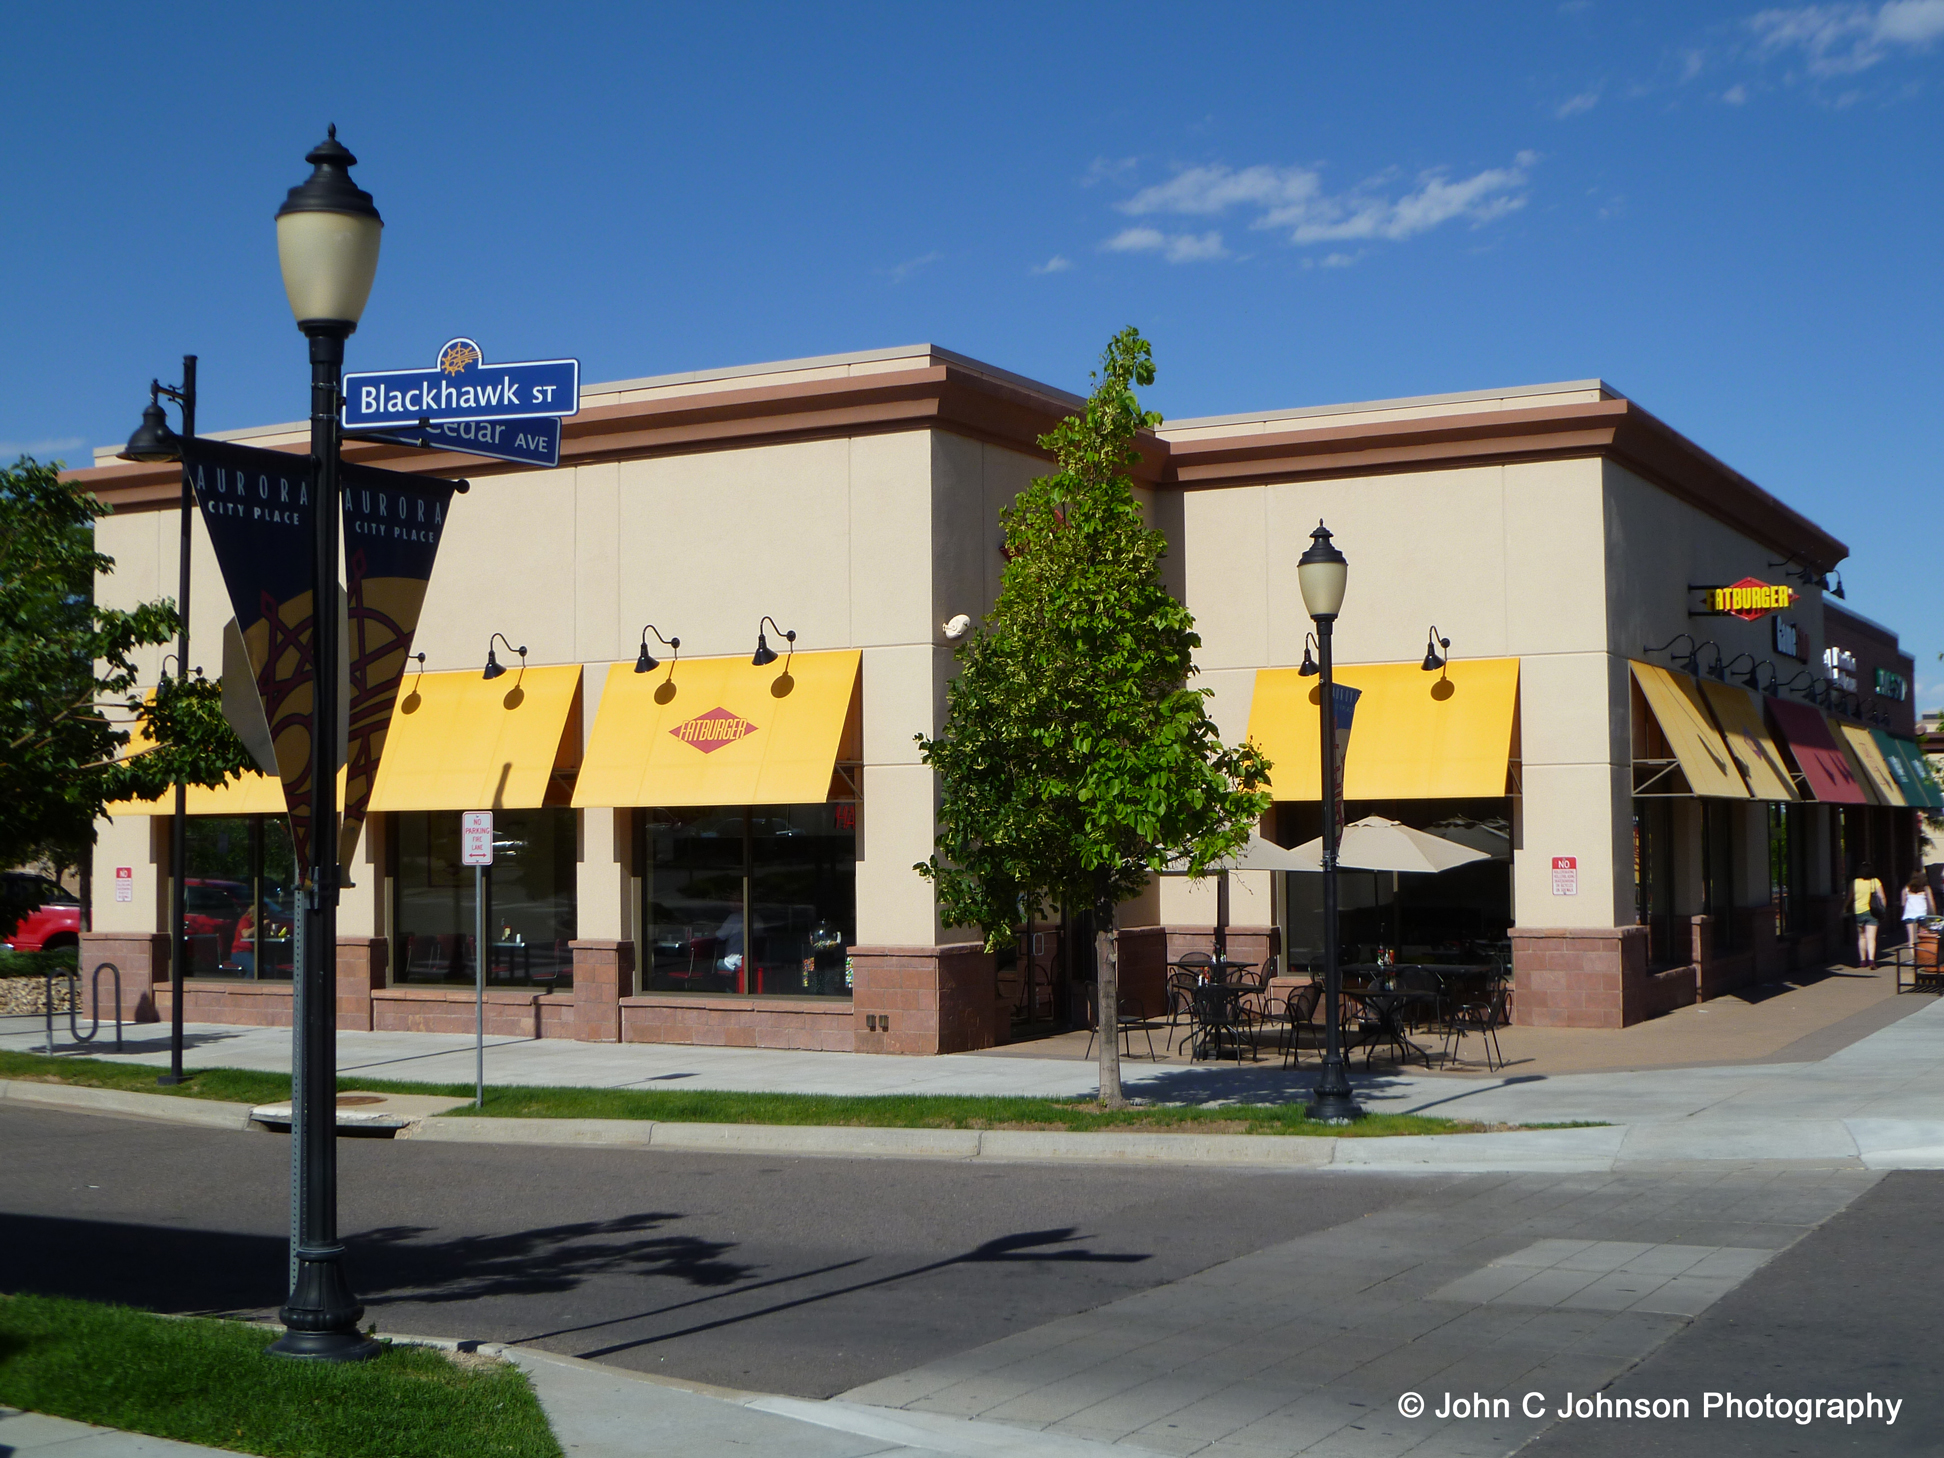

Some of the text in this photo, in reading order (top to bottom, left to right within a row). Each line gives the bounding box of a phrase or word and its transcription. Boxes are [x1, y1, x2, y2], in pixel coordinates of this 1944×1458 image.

[361, 376, 557, 414] Blackhawk ST
[514, 433, 548, 452] AVE
[197, 465, 308, 506] AURORA
[208, 500, 299, 525] CITY PLACE
[345, 487, 442, 525] AURORA
[355, 520, 435, 543] CITY PLACE
[1705, 585, 1789, 611] FATBURGER
[678, 718, 747, 741] FATBURGER
[465, 827, 490, 835] PARKING
[1558, 860, 1570, 869] NO
